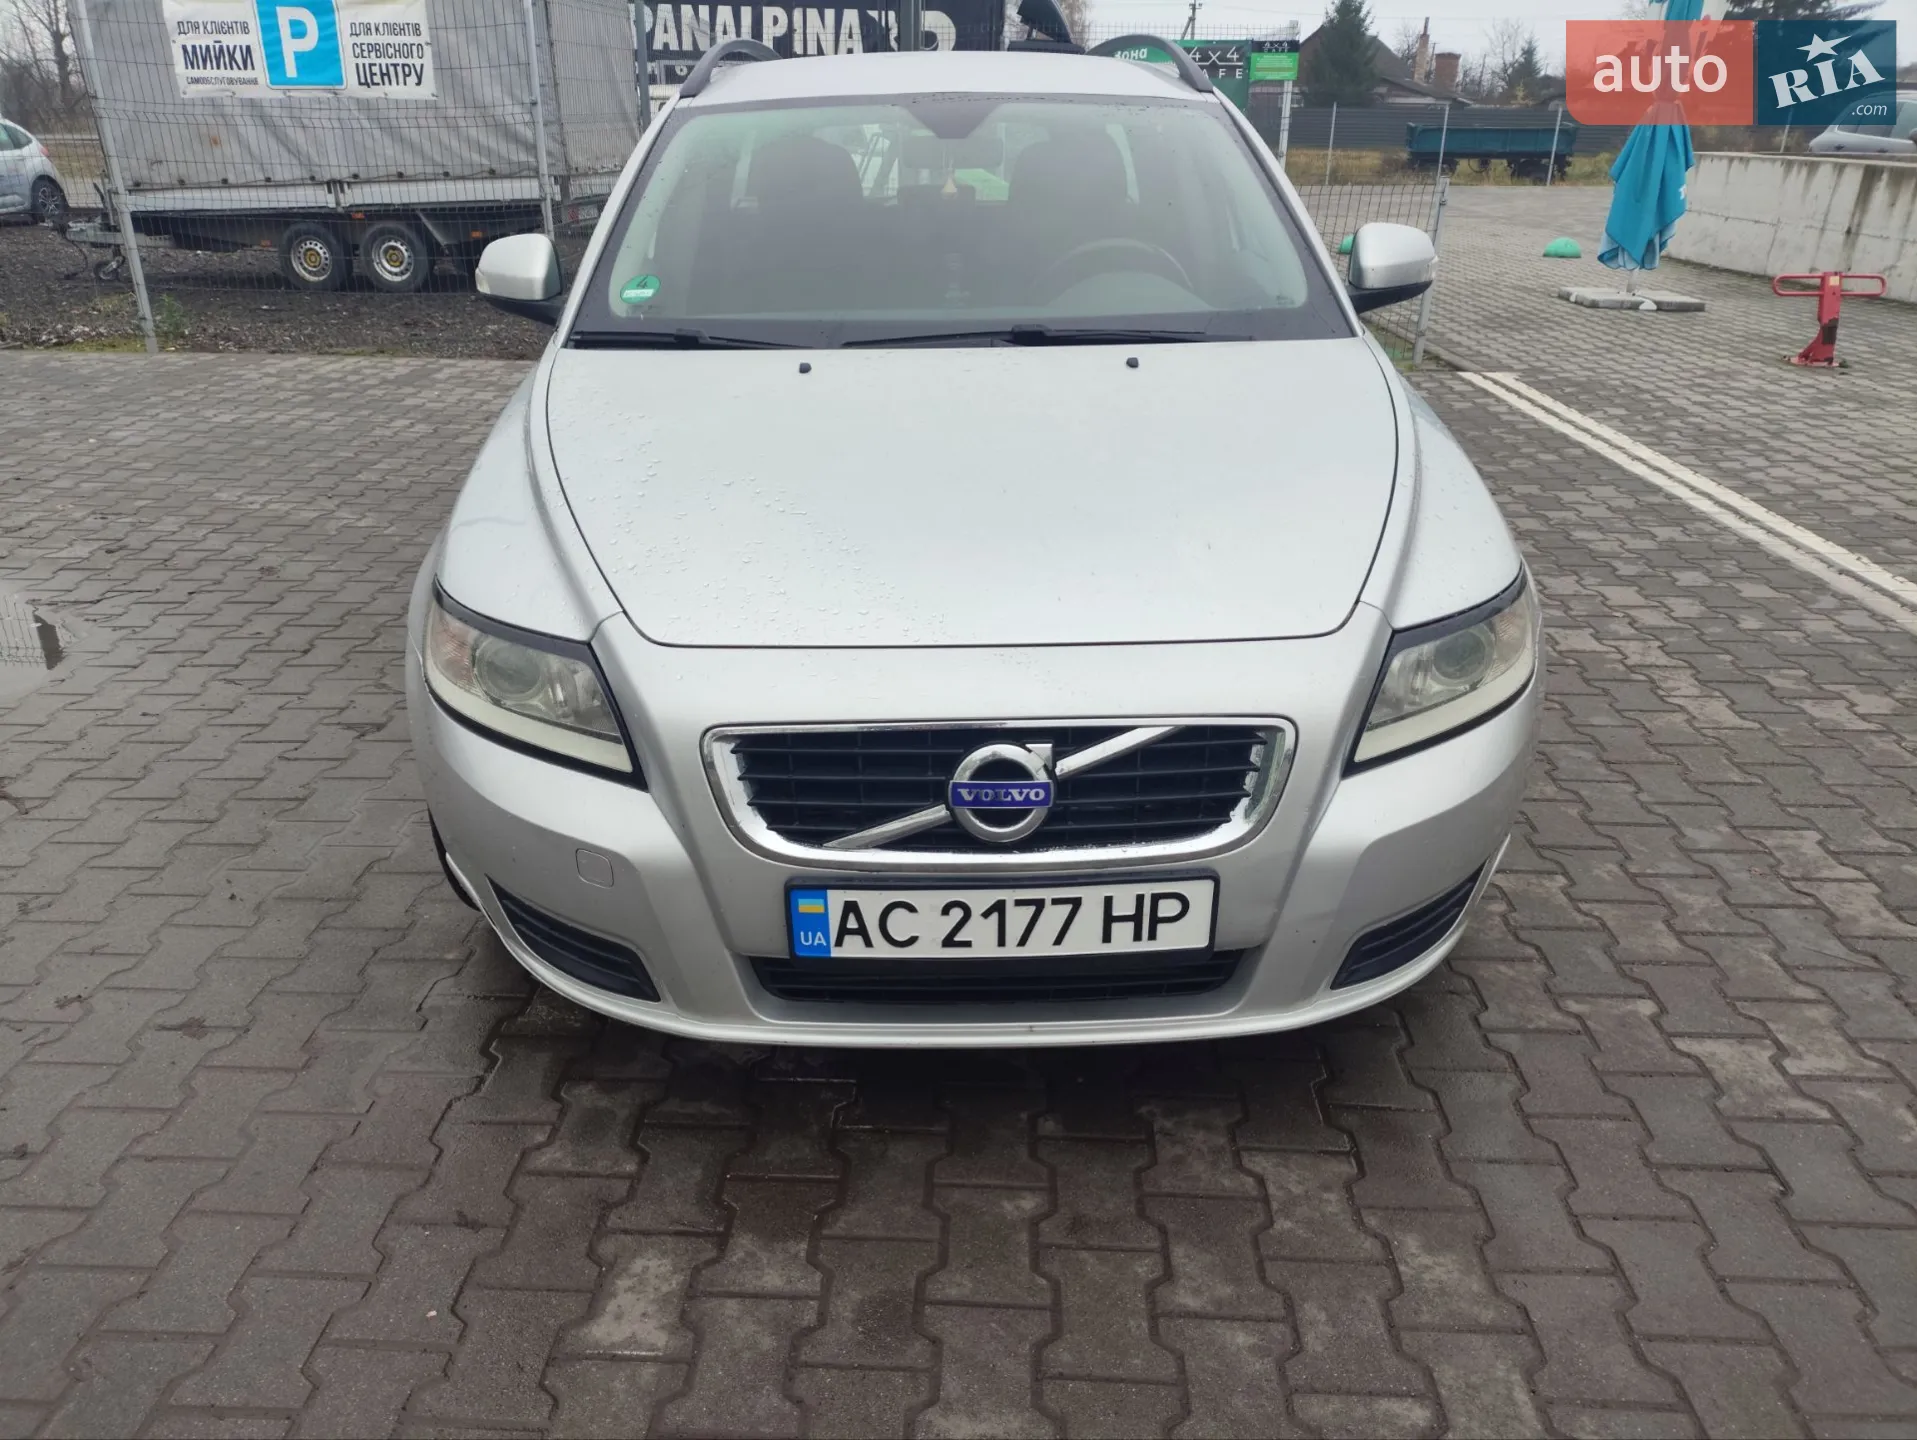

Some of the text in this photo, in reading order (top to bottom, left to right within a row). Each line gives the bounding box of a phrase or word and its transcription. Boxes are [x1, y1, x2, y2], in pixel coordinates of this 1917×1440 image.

[177, 21, 250, 35] ДЛЯ КЛІЄНТІВ
[350, 22, 422, 37] ДЛЯ КЛІЄНТІВ
[275, 6, 319, 78] P
[181, 40, 255, 71] МИЙКИ
[352, 42, 424, 59] СЕРВІСНОГО
[355, 63, 424, 88] ЦЕНТРУ
[1202, 68, 1243, 79] AFE
[957, 788, 1046, 802] VOLVO
[834, 892, 1190, 949] AC 2177 HP
[800, 931, 827, 946] UA
